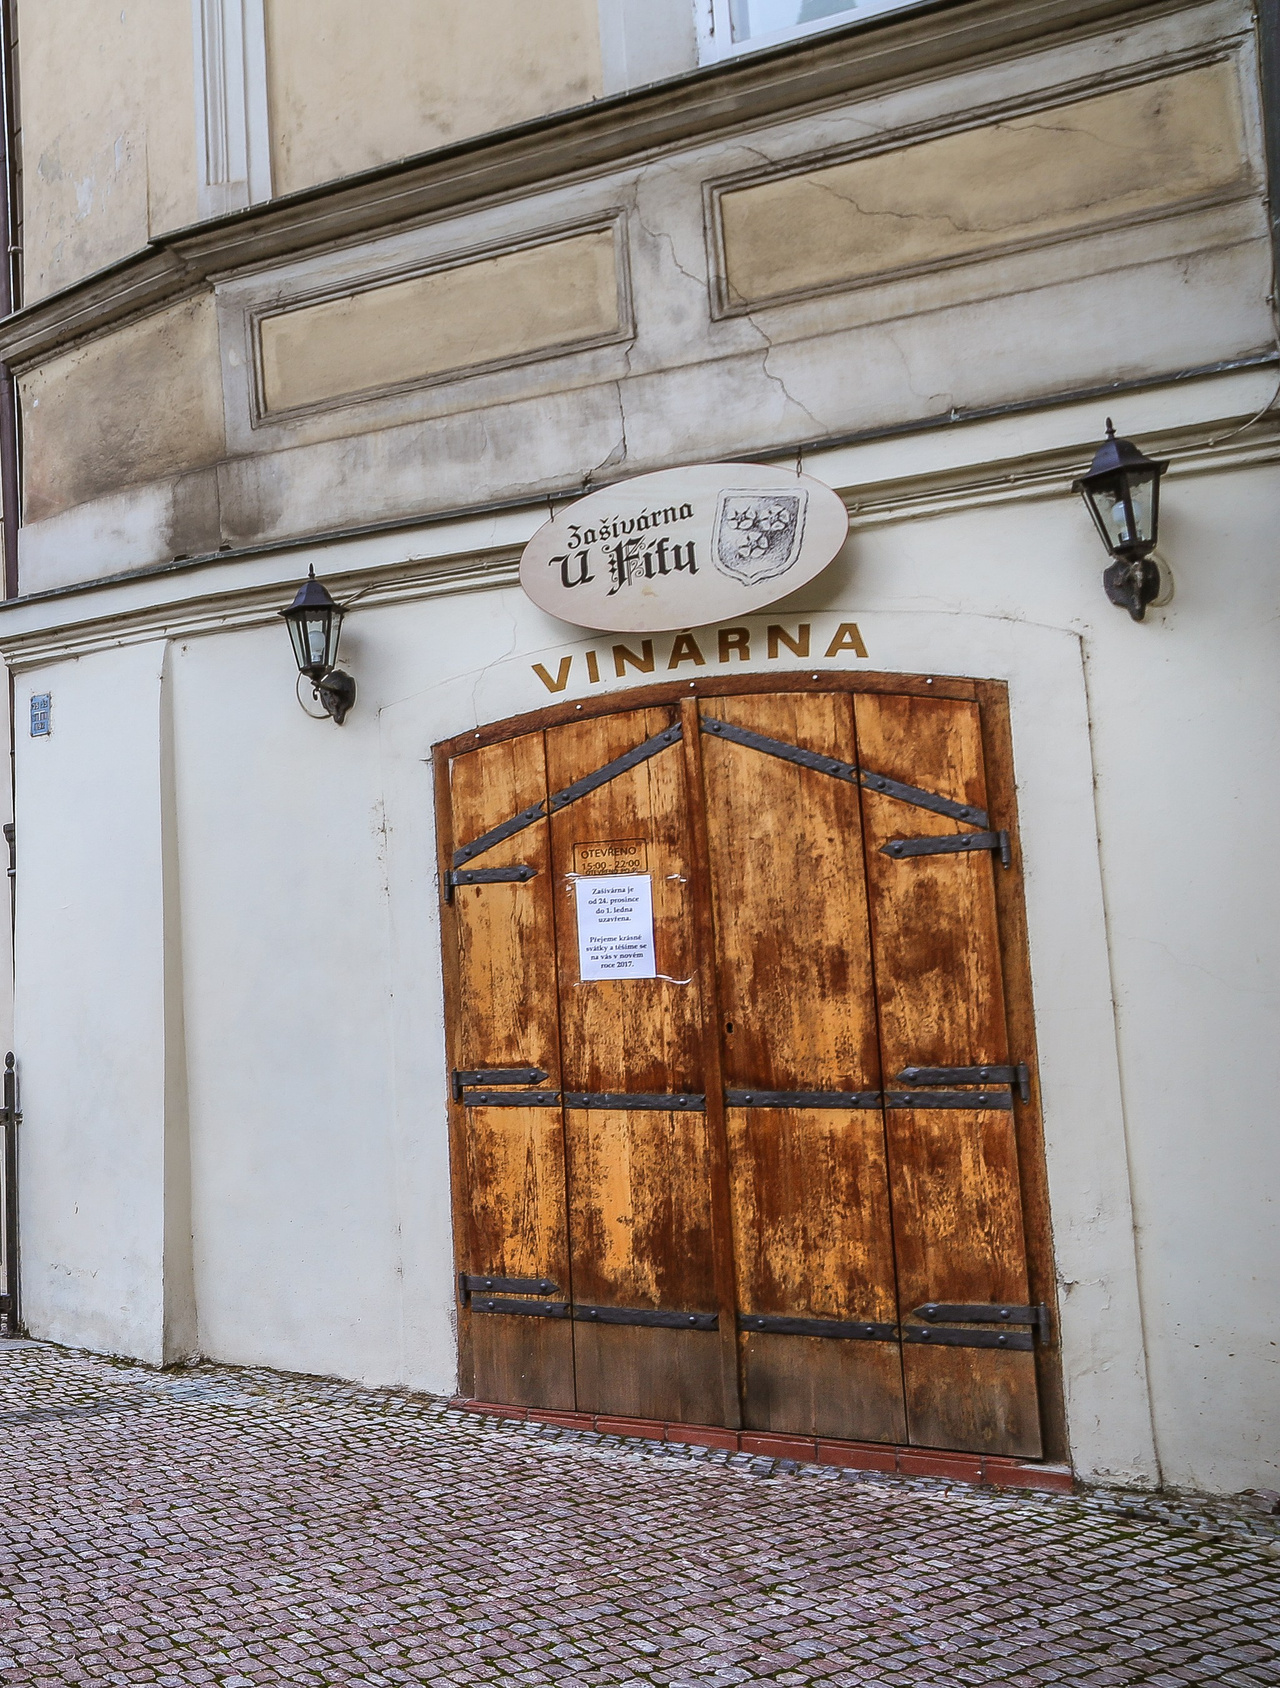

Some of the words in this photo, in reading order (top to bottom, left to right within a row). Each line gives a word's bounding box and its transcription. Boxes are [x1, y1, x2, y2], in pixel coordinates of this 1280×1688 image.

[548, 549, 595, 588] U
[531, 622, 869, 694] VINÁRNA
[581, 846, 637, 859] OTEVŘENO
[582, 861, 607, 870] 15:00
[615, 859, 640, 869] 22:00
[627, 886, 634, 894] je
[610, 896, 639, 905] prosince
[586, 944, 608, 952] svátky
[617, 960, 634, 968] 2017.
